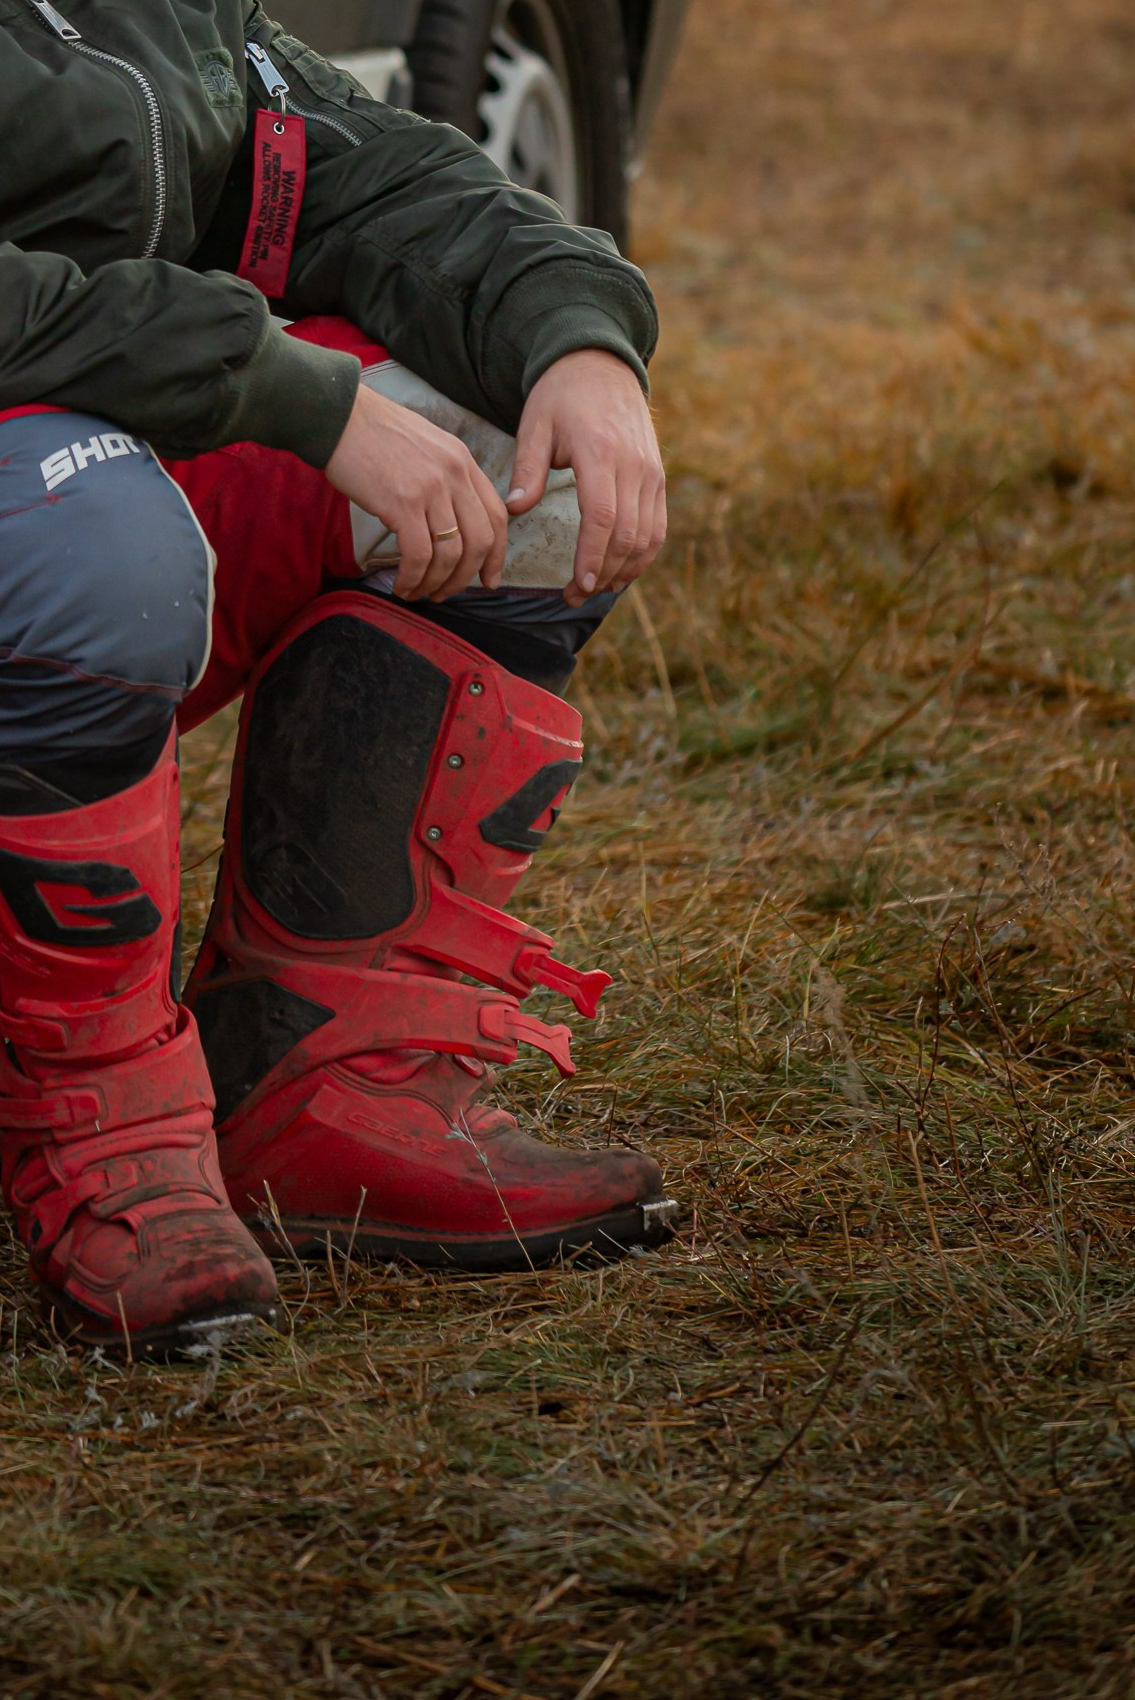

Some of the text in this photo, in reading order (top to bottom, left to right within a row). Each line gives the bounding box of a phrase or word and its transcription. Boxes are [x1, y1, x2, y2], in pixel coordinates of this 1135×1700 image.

[262, 141, 272, 182] ALLOWS
[271, 152, 282, 203] REMOVING
[258, 183, 270, 223] ROCKET
[265, 205, 277, 243] SAFETY
[272, 170, 296, 246] WARNING
[40, 432, 141, 492] SHOT
